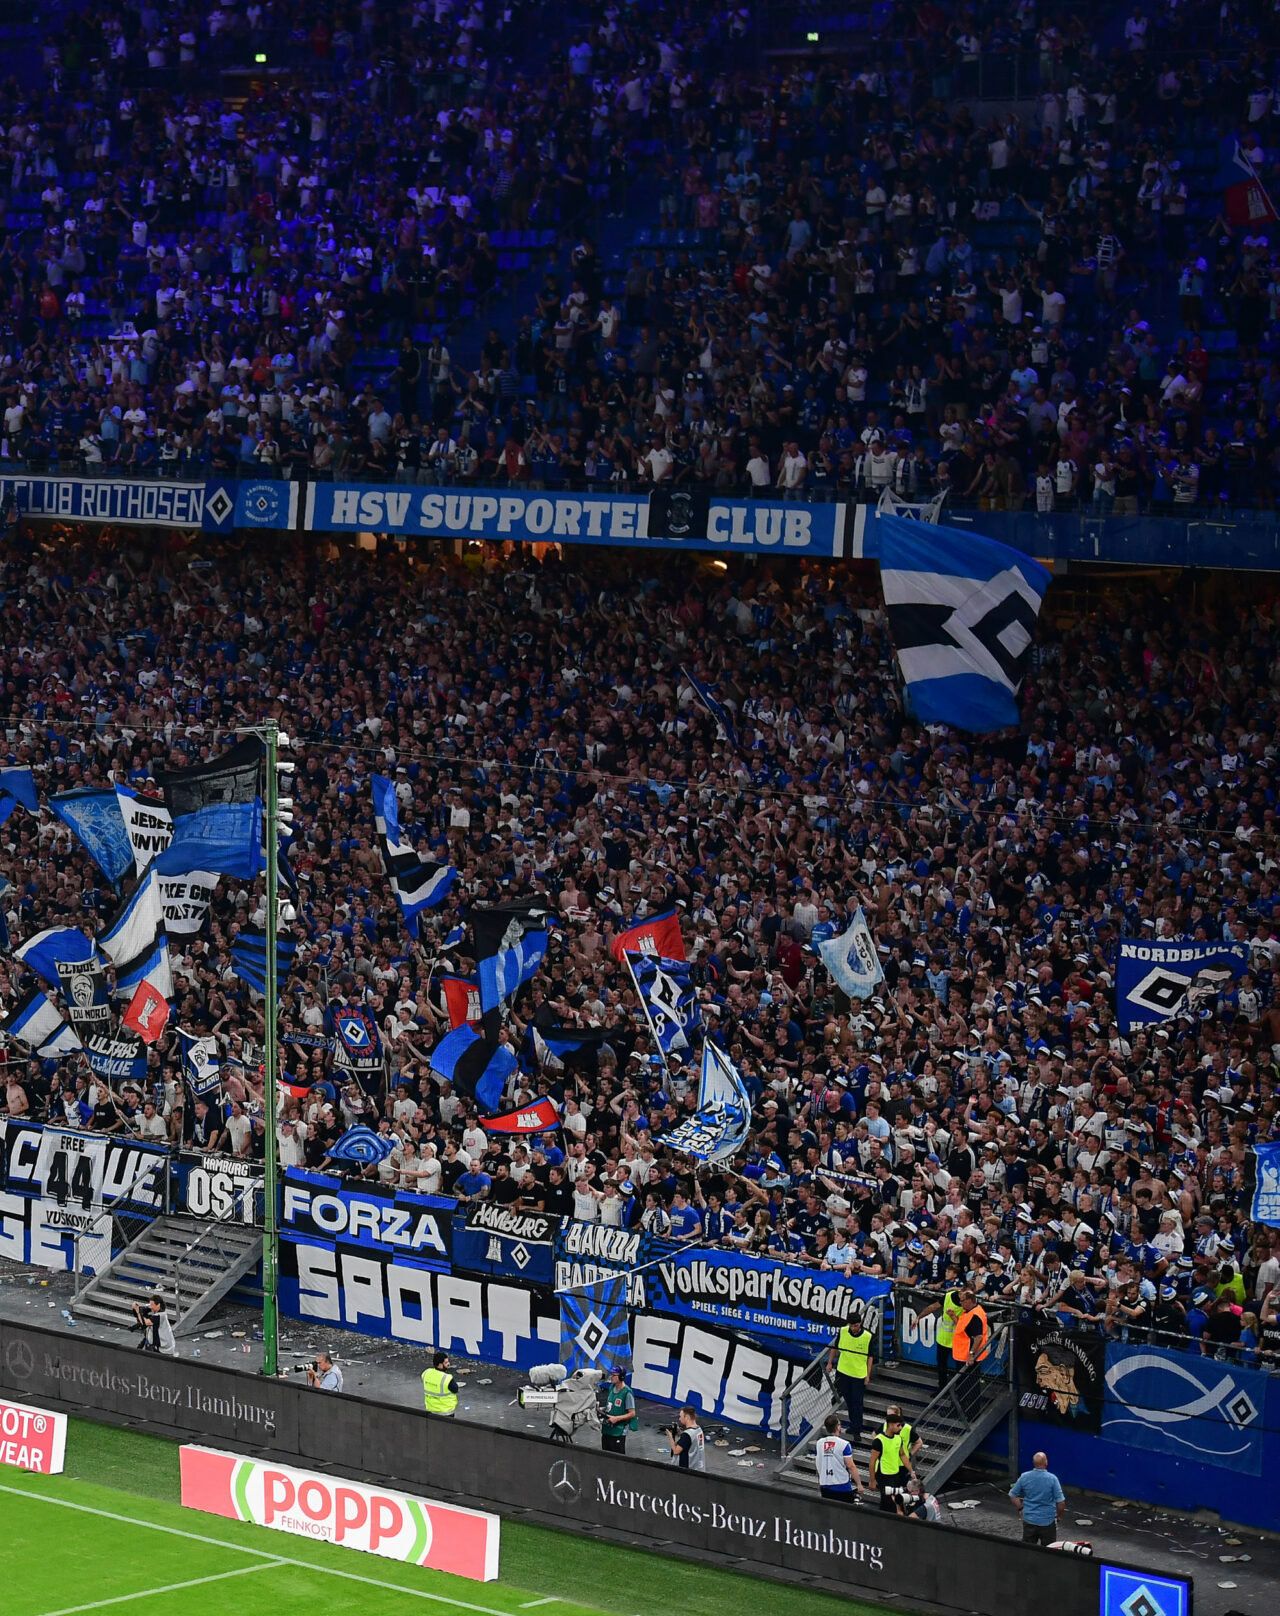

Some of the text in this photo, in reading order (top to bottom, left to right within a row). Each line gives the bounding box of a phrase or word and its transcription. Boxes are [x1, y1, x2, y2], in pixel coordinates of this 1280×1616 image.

[14, 481, 74, 516] CLUB
[80, 484, 207, 522] ROTHOSEN
[330, 490, 813, 548] HSV SUPPORTE CLUB
[131, 811, 176, 836] JEDER
[89, 1033, 140, 1058] ULTRAS
[60, 1135, 85, 1152] FREE
[46, 1151, 96, 1212] 44
[202, 1156, 251, 1178] HAMBURG
[186, 1168, 267, 1232] OST
[283, 1185, 448, 1254] FORZA
[472, 1202, 550, 1240] HAMBURG
[566, 1222, 642, 1265] BANDA
[658, 1260, 881, 1336] Volksparkstadion
[691, 1300, 721, 1317] SPIELE,
[721, 1305, 743, 1321] SIEGE
[744, 1312, 752, 1321] &
[753, 1312, 798, 1332] EMOTIONEN
[807, 1322, 825, 1338] SEIT
[1064, 1337, 1098, 1383] HAMBURG
[263, 1470, 405, 1551] popp
[596, 1477, 885, 1570] Mercedes-Benz Hamburg
